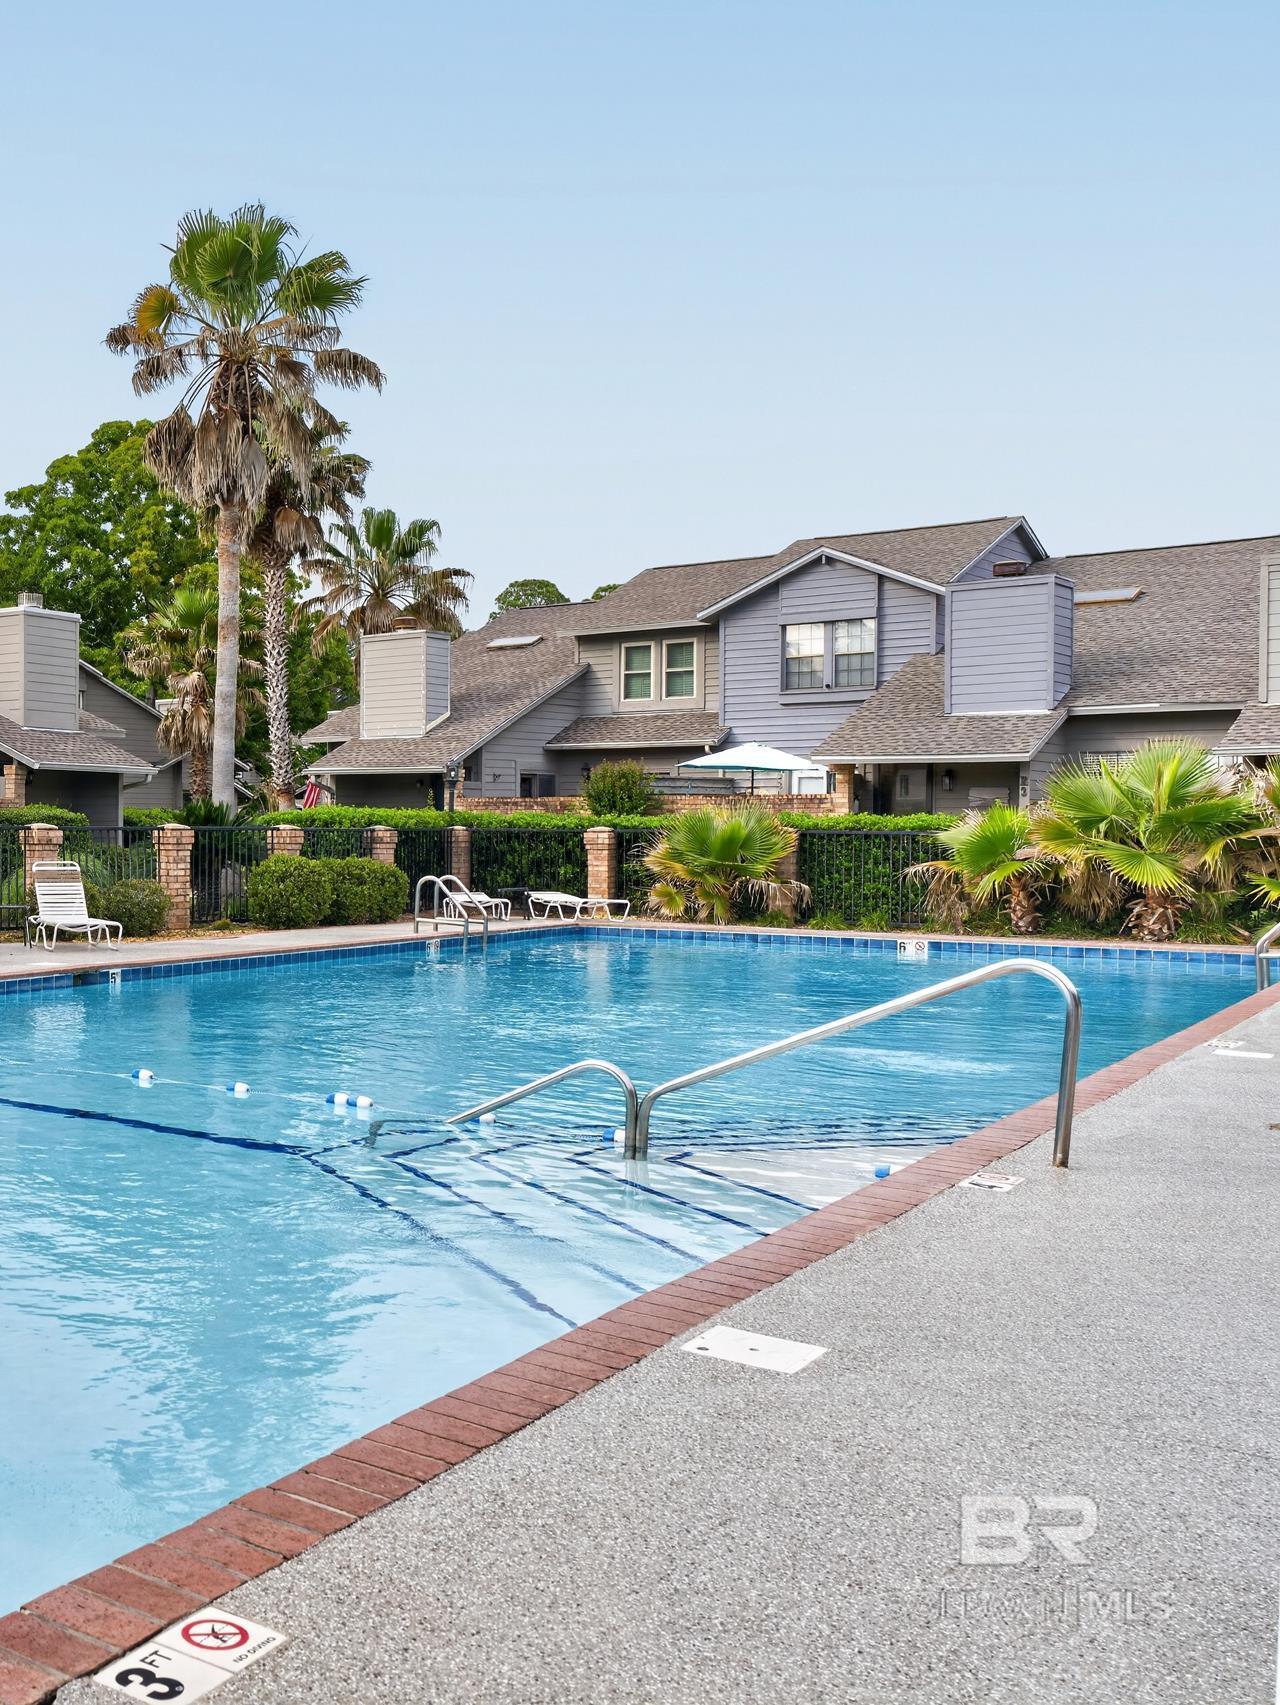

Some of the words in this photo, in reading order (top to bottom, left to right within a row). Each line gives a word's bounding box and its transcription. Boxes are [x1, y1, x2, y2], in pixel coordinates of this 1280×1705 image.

[111, 972, 116, 984] 5
[139, 1649, 172, 1668] FT
[233, 1654, 248, 1663] NO
[115, 1667, 185, 1701] 3
